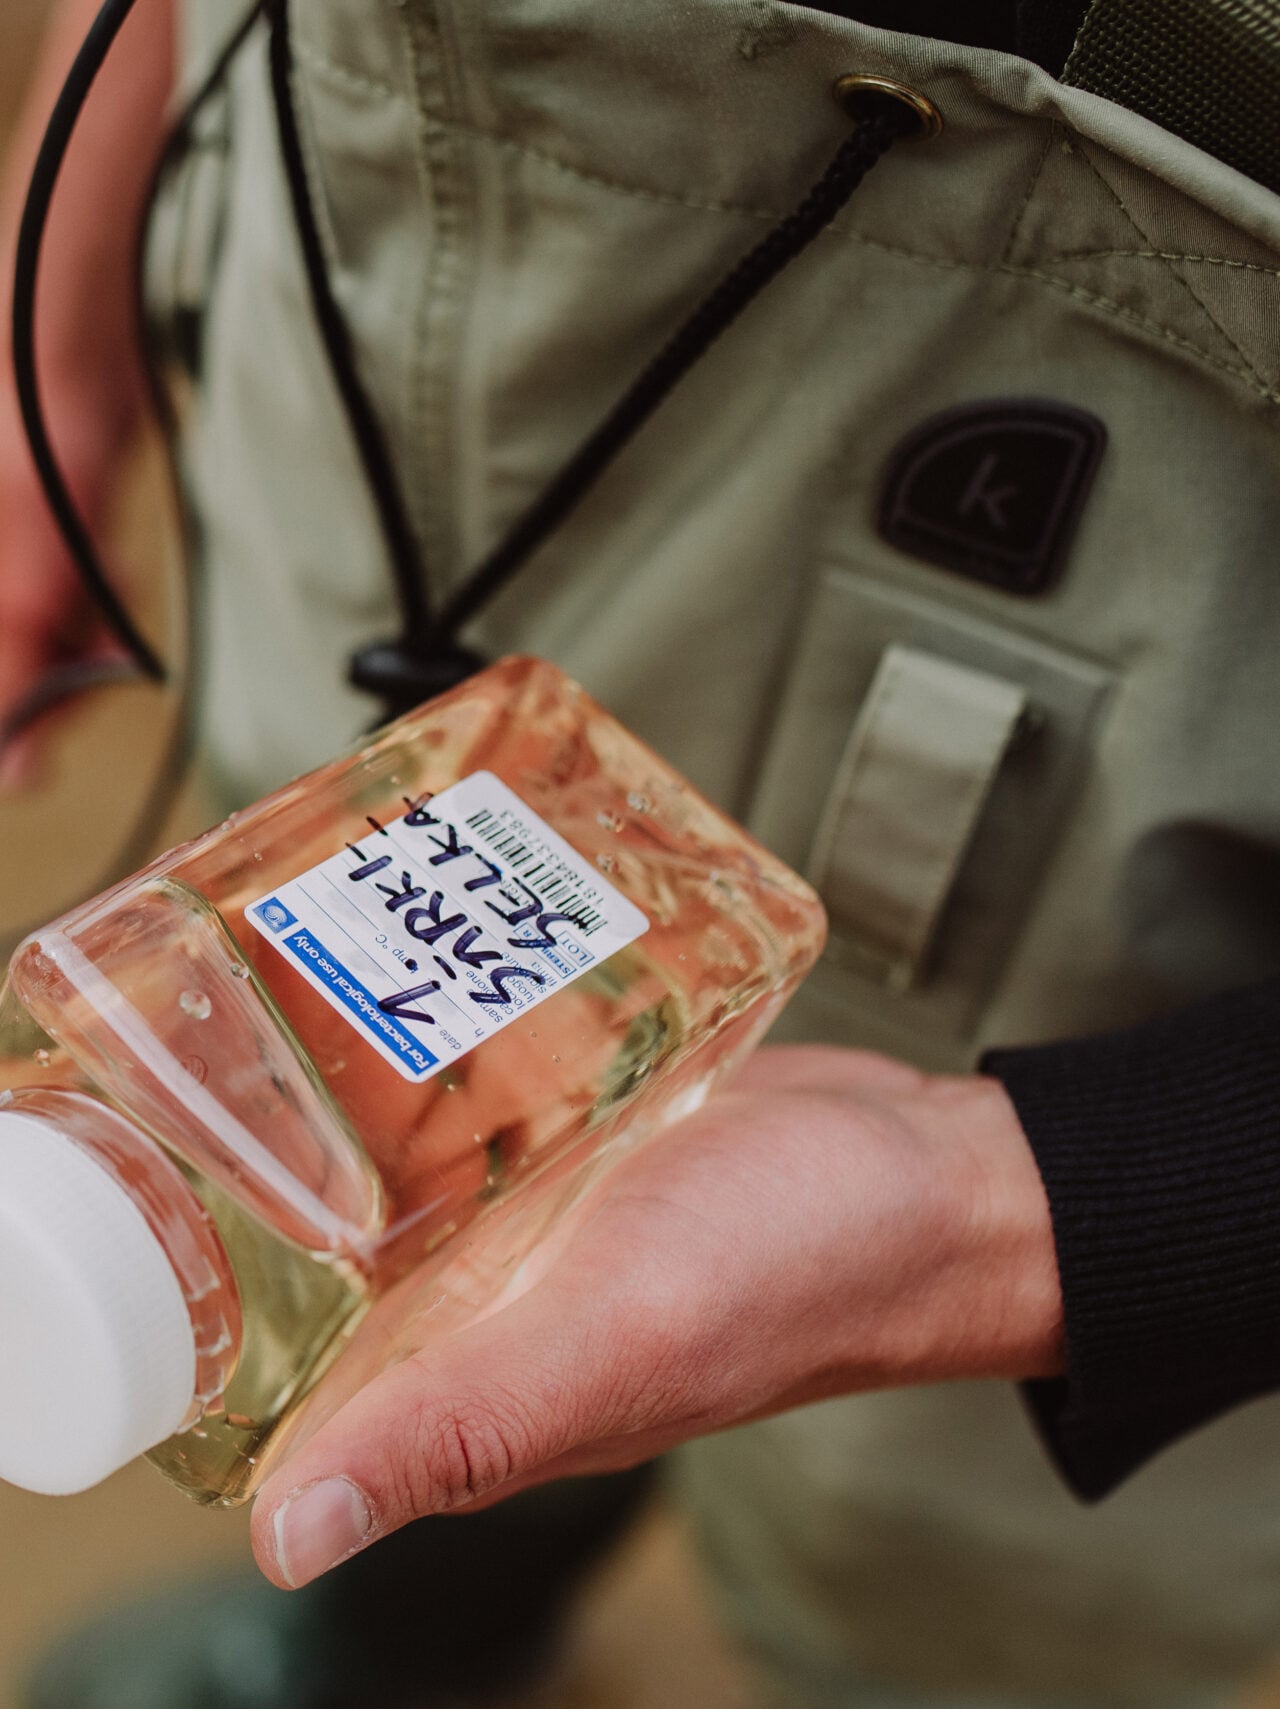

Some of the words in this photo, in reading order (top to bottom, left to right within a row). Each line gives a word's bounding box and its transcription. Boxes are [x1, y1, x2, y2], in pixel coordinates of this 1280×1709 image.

[293, 936, 319, 958] only
[559, 938, 588, 962] LOT
[317, 957, 337, 977] use
[391, 948, 419, 974] tmp
[465, 970, 513, 1014] capione
[332, 976, 411, 1051] bacteriological
[465, 988, 503, 1023] same
[439, 1029, 461, 1049] date
[474, 1027, 484, 1037] h
[407, 1049, 429, 1068] For
